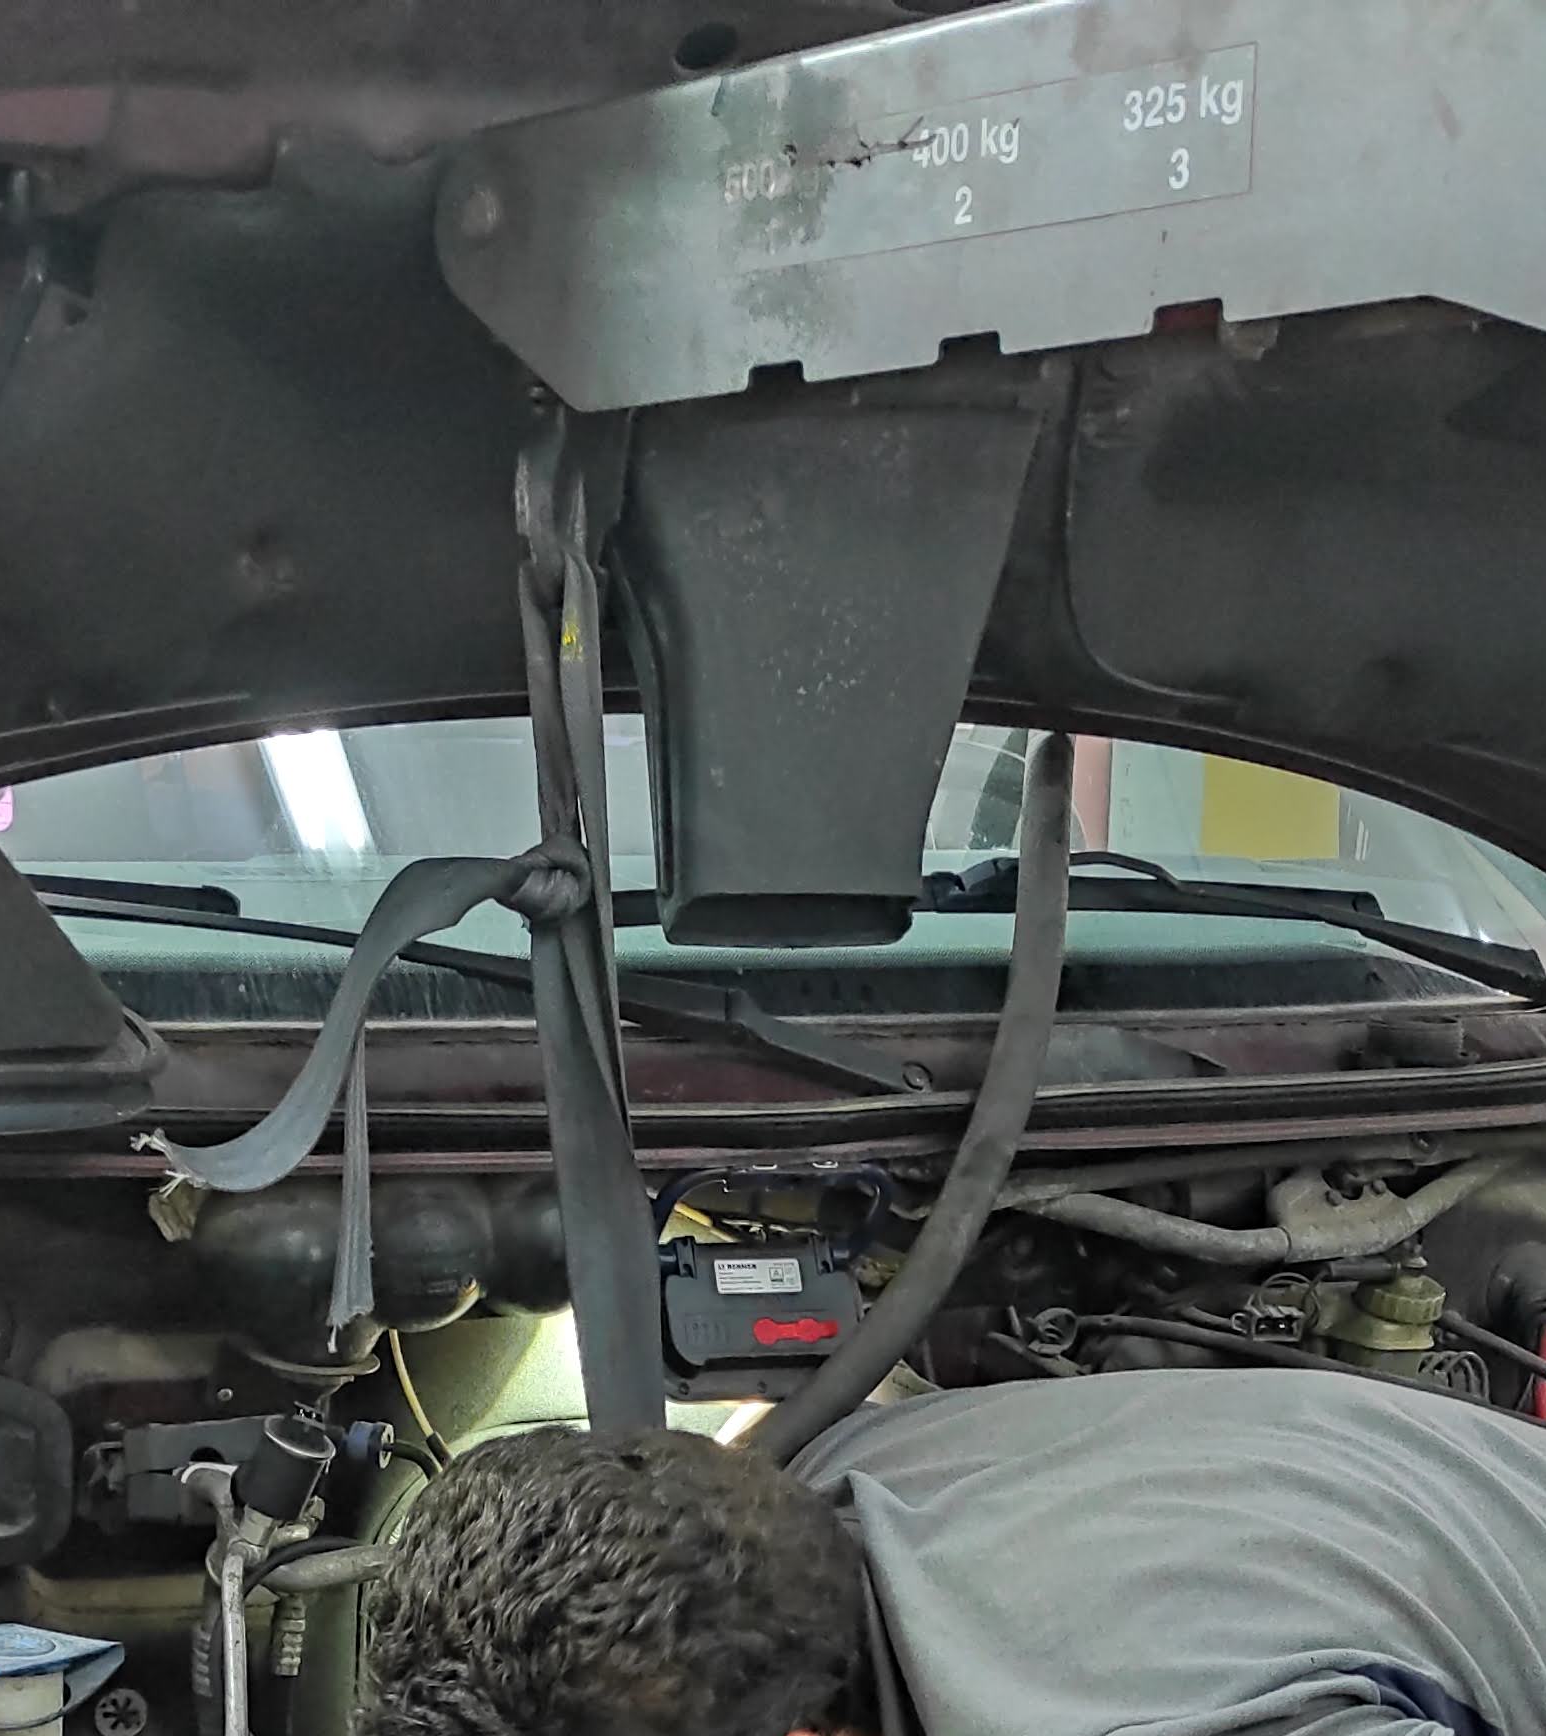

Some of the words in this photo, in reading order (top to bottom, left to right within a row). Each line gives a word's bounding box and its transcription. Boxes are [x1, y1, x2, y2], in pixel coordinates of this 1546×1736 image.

[1123, 82, 1186, 131] 325
[1200, 74, 1243, 125] kg
[913, 123, 969, 168] 400
[980, 118, 1020, 164] kg
[1168, 147, 1190, 189] 3
[954, 185, 973, 225] 2
